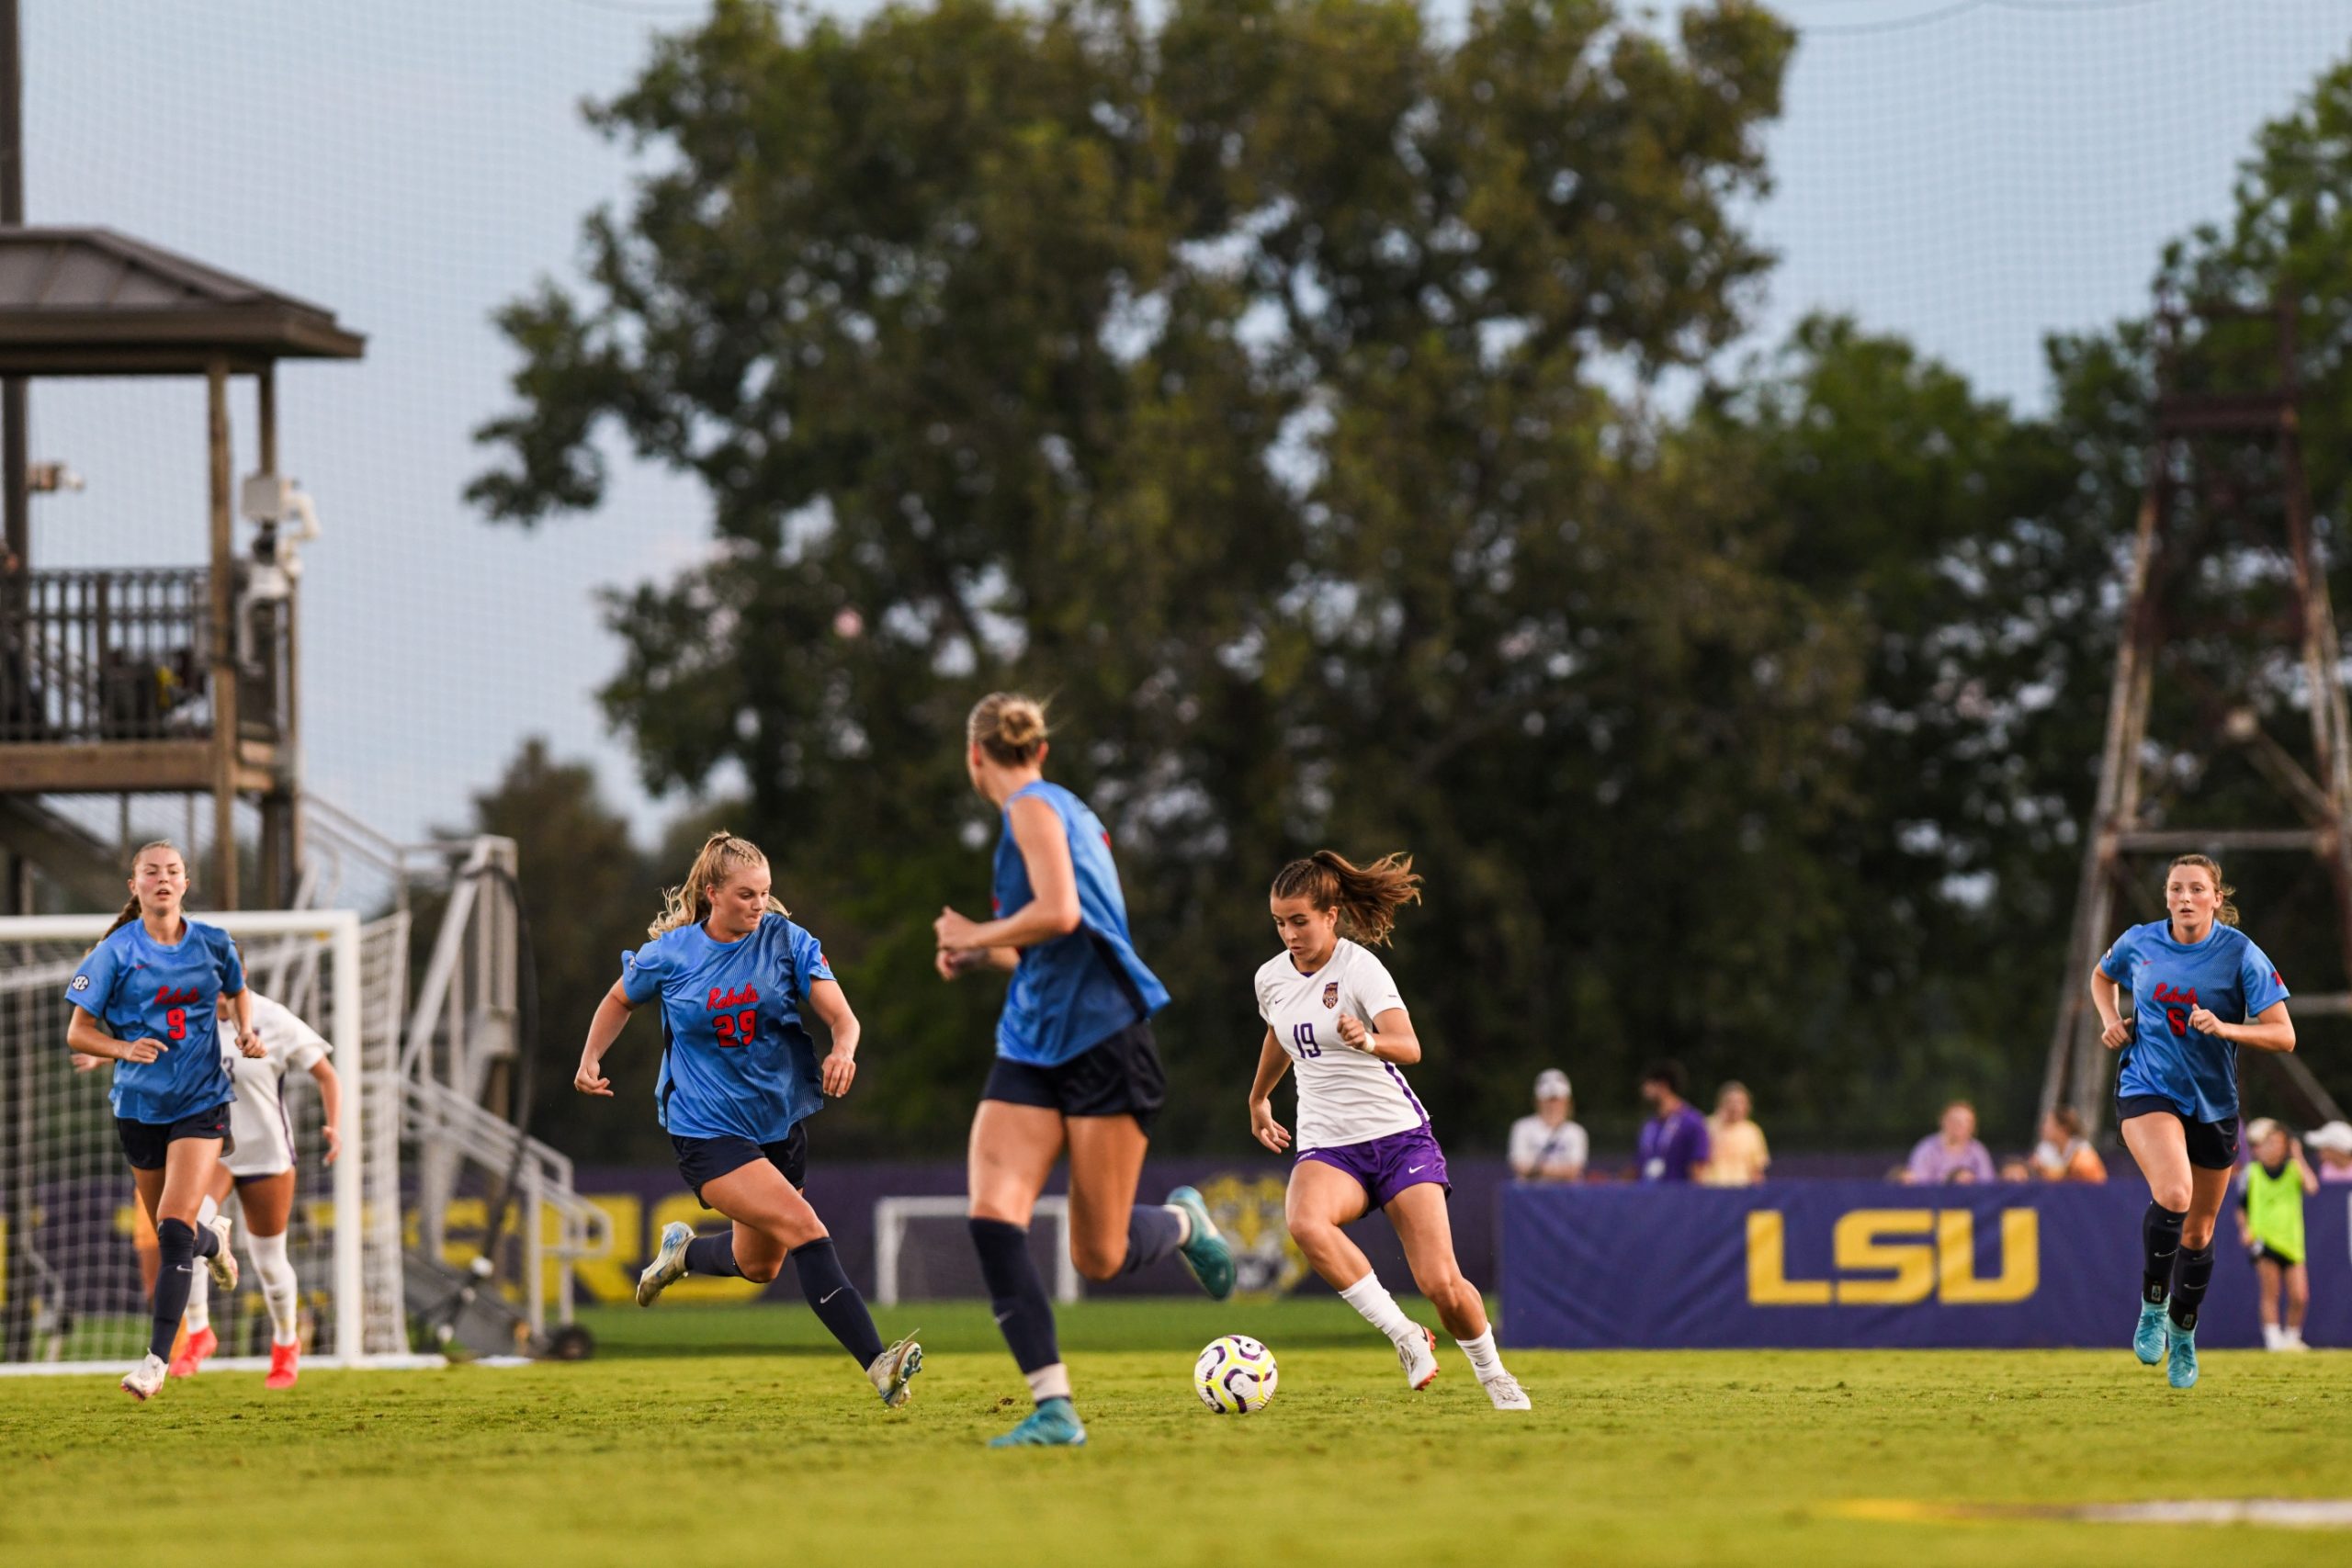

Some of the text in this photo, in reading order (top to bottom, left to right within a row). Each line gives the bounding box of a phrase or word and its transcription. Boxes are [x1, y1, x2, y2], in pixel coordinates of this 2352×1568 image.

[707, 983, 759, 1010] Rebels
[2153, 982, 2198, 1004] Rebels
[166, 1008, 187, 1040] 9
[713, 1010, 757, 1047] 29
[2166, 1008, 2187, 1037] 6
[1294, 1022, 1322, 1059] 19
[1747, 1208, 2039, 1305] LSU
